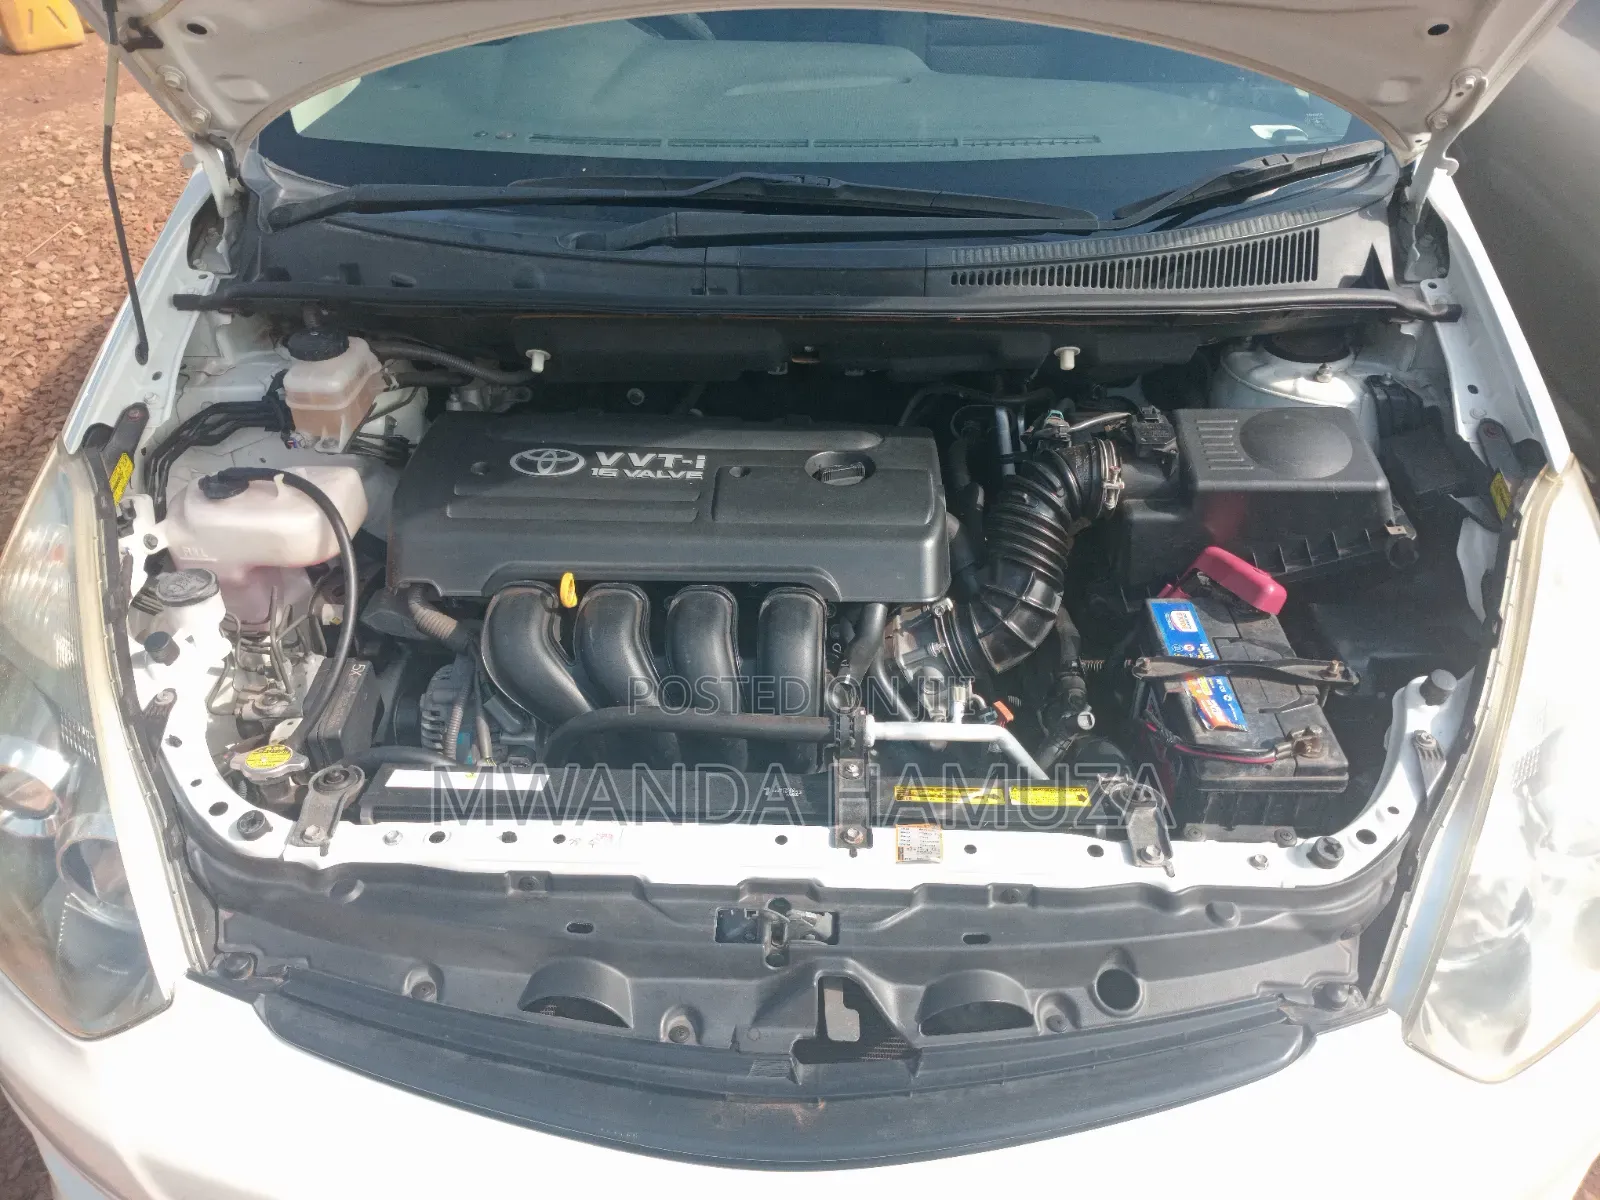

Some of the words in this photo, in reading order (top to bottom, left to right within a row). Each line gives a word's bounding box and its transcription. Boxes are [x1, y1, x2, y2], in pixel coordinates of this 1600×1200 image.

[595, 451, 706, 469] VVT-i
[591, 467, 619, 478] 16
[622, 468, 704, 480] VALVE
